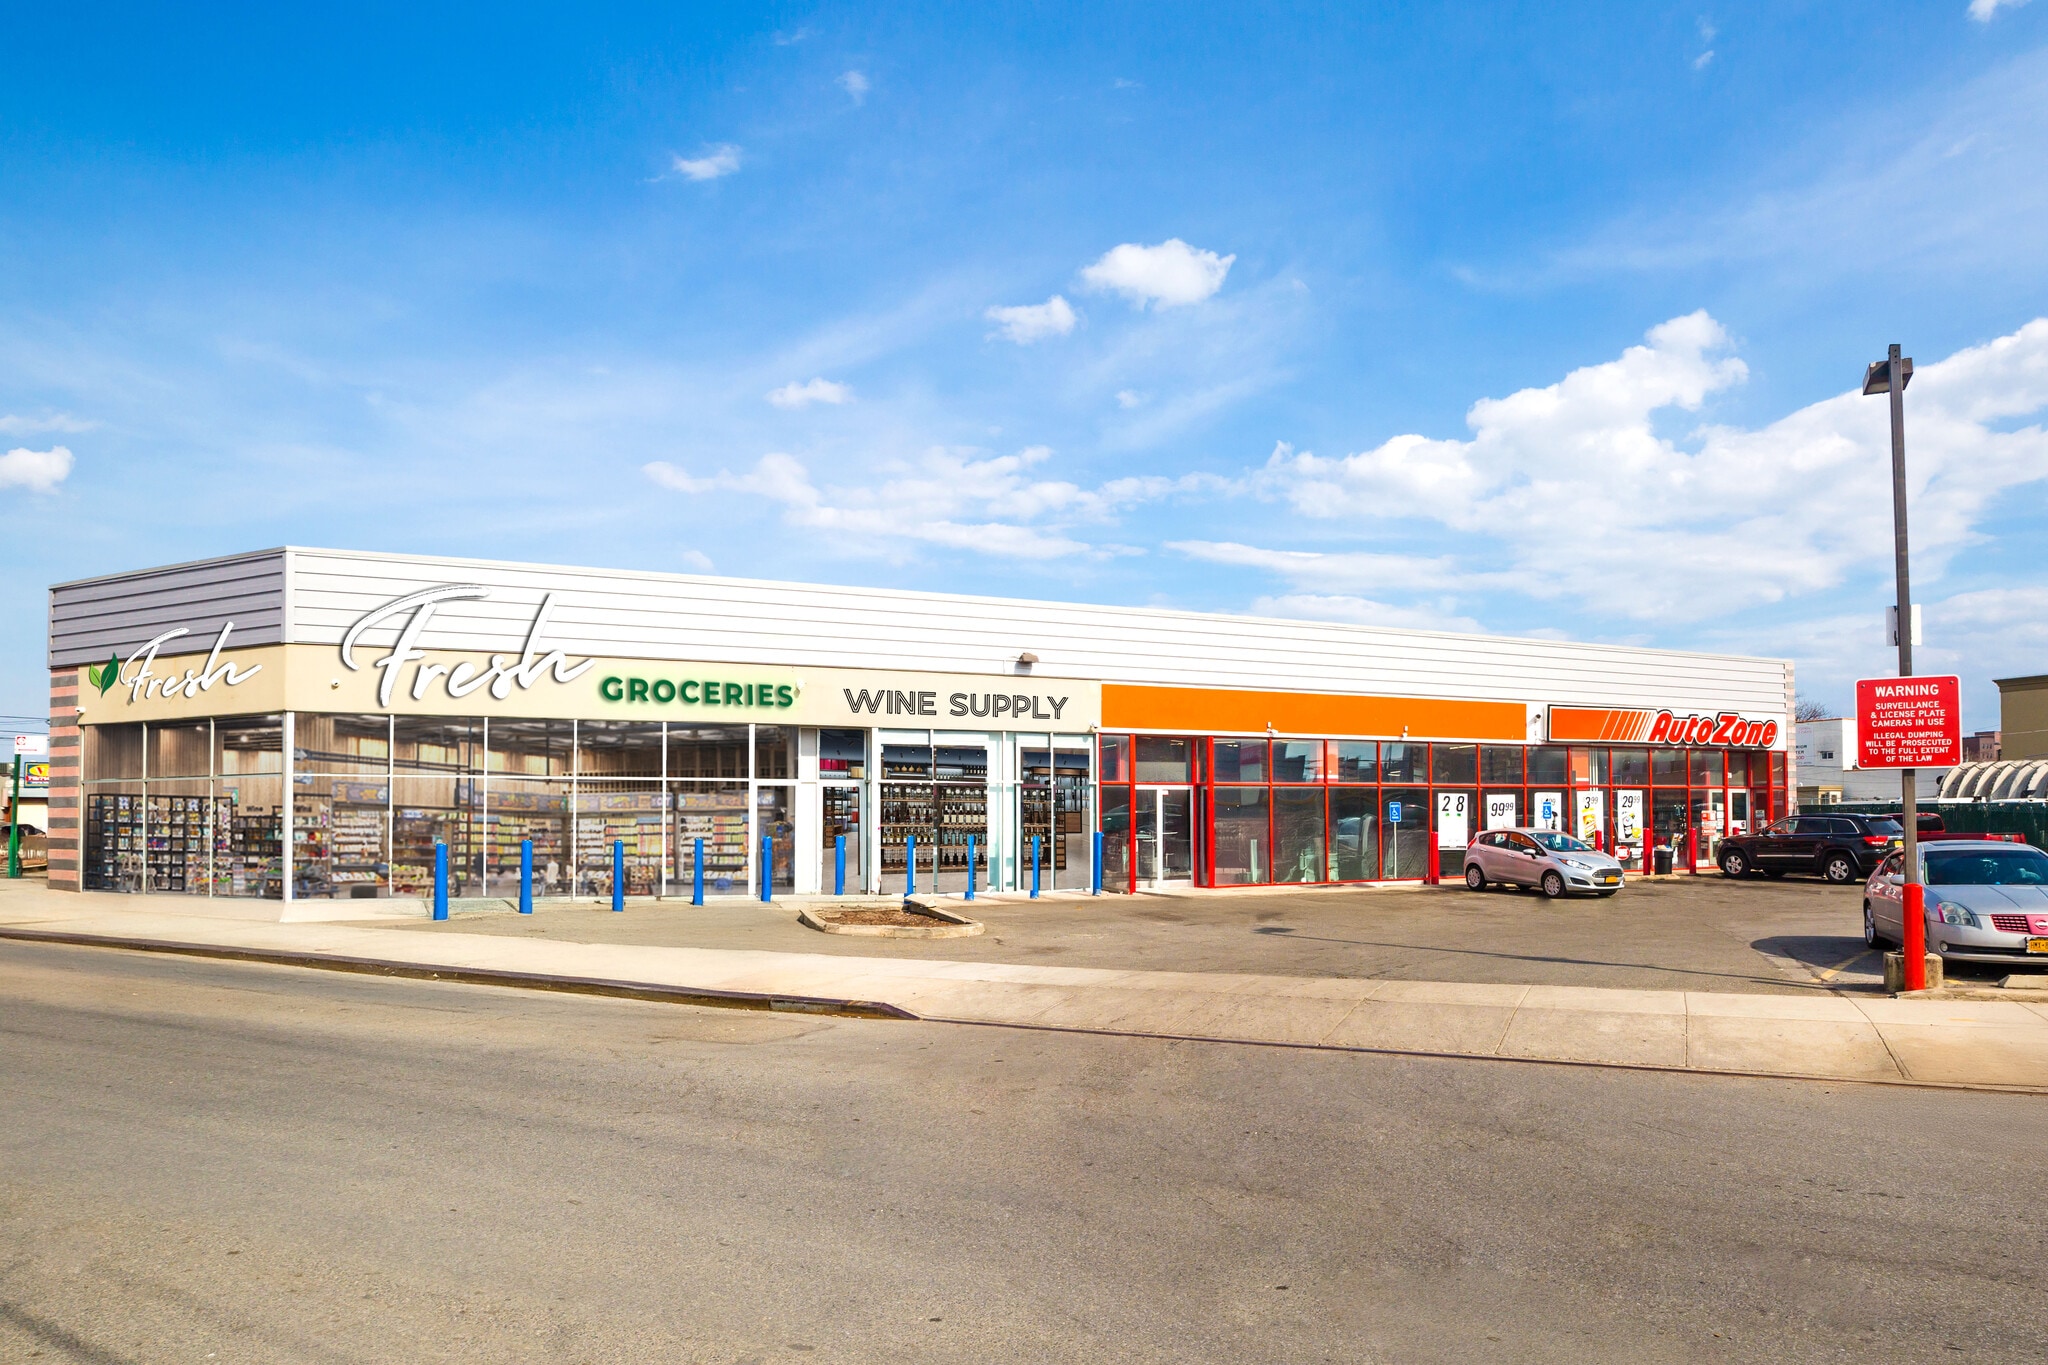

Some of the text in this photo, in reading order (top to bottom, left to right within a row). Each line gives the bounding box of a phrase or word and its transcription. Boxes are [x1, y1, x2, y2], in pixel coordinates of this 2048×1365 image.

[342, 583, 596, 708] Fresh
[120, 620, 263, 703] Fresh
[601, 676, 794, 708] GROCERIES
[1875, 684, 1939, 698] WARNING
[843, 688, 1069, 720] WINE SUPPLY
[1875, 700, 1940, 710] SURVEILLANCE
[1870, 709, 1946, 719] & LICENSE PLATE
[1647, 711, 1778, 746] AutoZone
[1871, 718, 1945, 727] CAMERAS IN USE
[1873, 731, 1944, 740] ILLEGAL DUMPING
[1920, 746, 1950, 754] EXTENT
[1886, 755, 1896, 763] OF
[1442, 795, 1465, 812] 2 8
